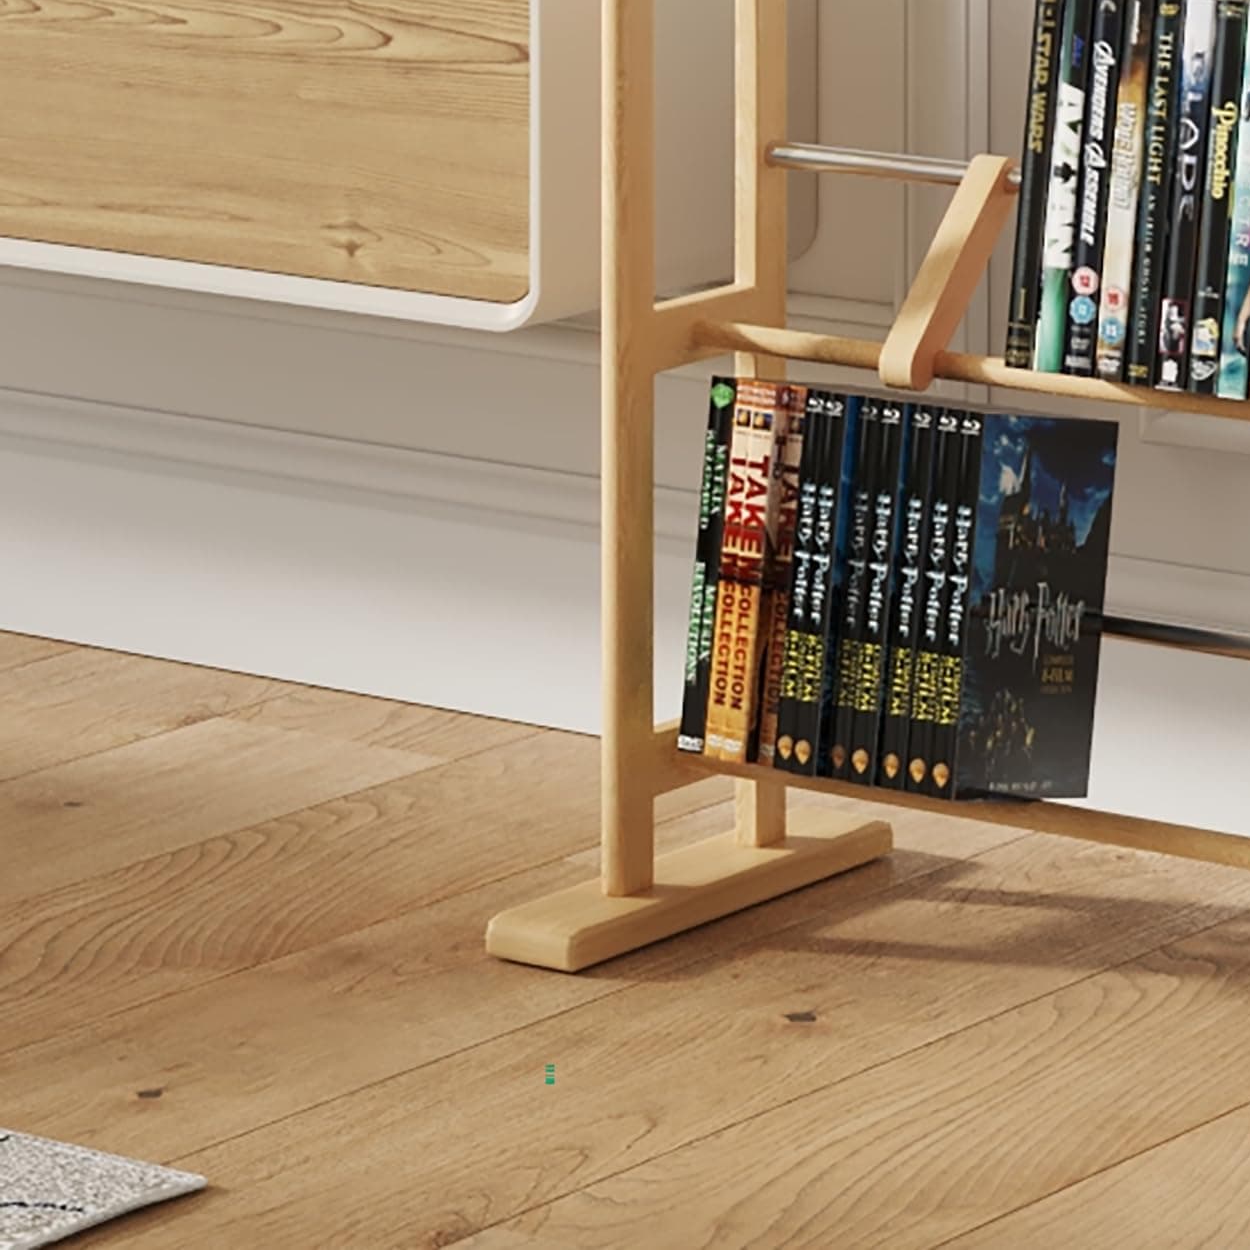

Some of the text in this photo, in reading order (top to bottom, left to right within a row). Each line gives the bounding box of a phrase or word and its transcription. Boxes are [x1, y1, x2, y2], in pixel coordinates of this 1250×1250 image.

[1033, 30, 1053, 88] STAR
[1152, 78, 1169, 119] LAST
[1157, 32, 1174, 70] THE
[1028, 91, 1047, 153] WARS
[1147, 124, 1166, 185] LIGHT
[1178, 51, 1206, 222] BLADE
[1211, 100, 1238, 199] Pinocchio
[1080, 142, 1107, 246] ASSEMBLE
[711, 444, 728, 514] MATRIX
[730, 455, 770, 711] TAKEN COLLECTION
[793, 480, 816, 619] Harry Potter
[811, 484, 834, 624] Harry Potter
[867, 493, 892, 632] Harry Potter
[899, 497, 922, 637] Harry Potter
[924, 502, 948, 641] Harry Potter
[948, 505, 972, 646] Harry Potter
[698, 584, 717, 662] MATRIX
[714, 583, 736, 706] COLLECTION
[984, 581, 1085, 676] Harry Potter
